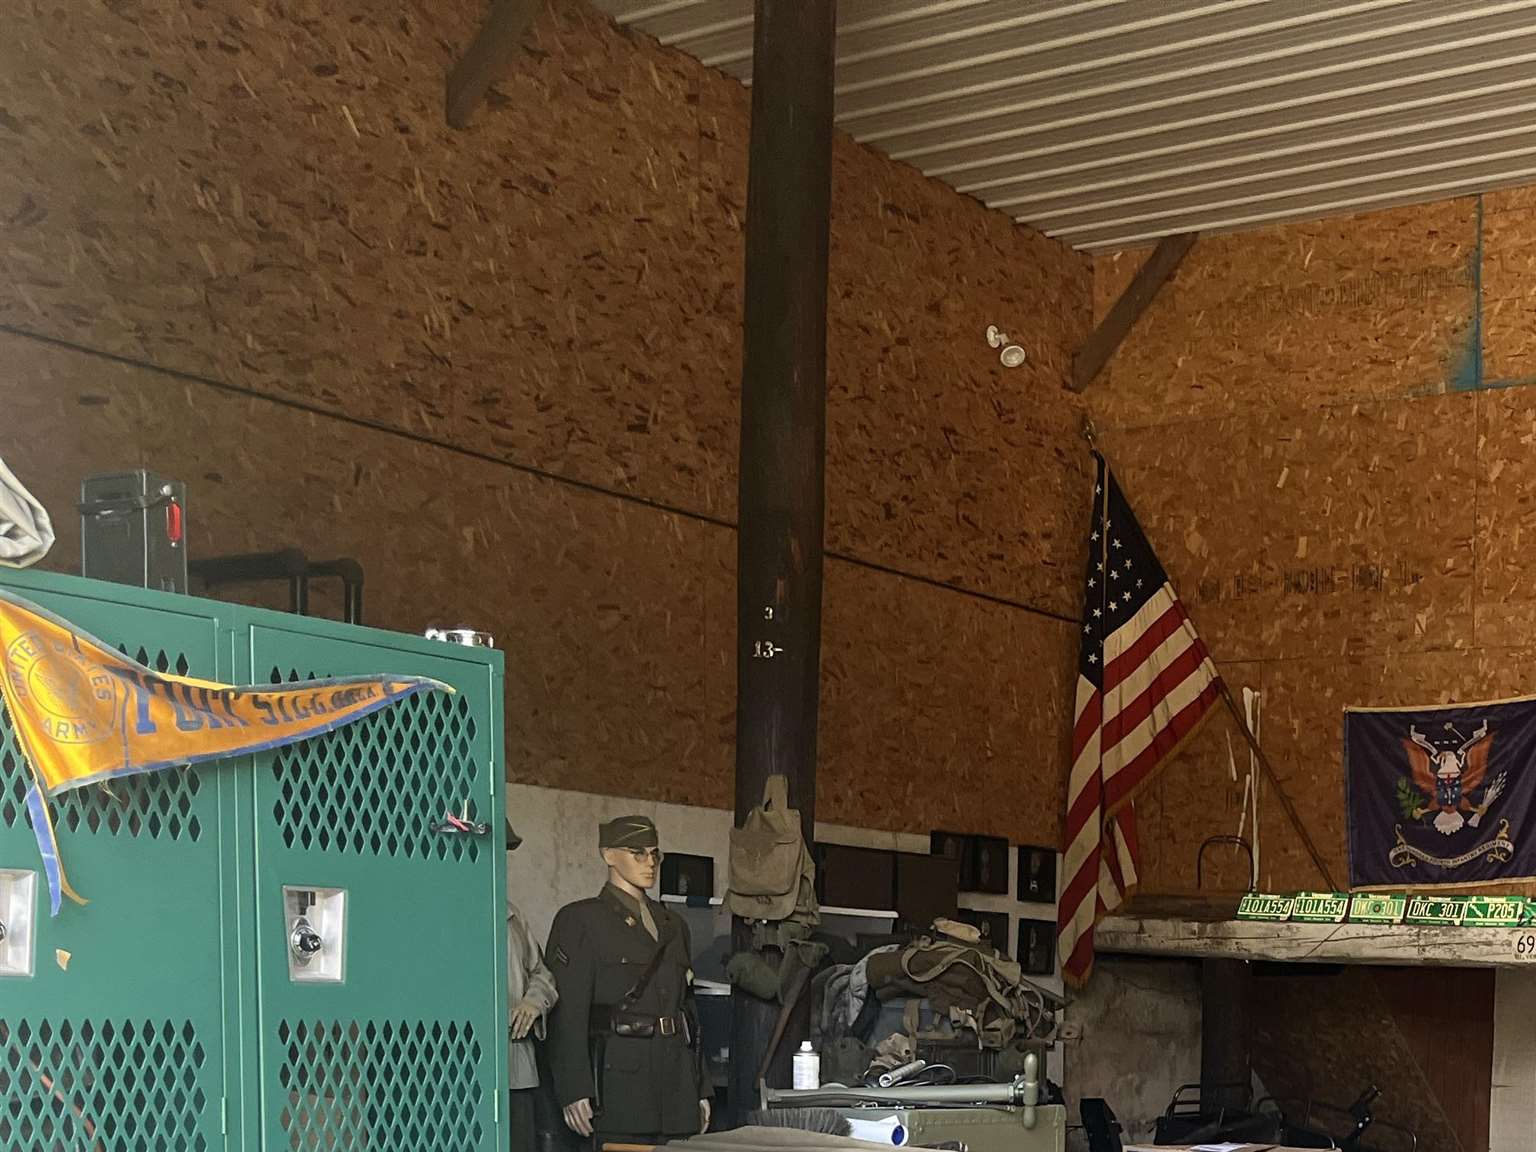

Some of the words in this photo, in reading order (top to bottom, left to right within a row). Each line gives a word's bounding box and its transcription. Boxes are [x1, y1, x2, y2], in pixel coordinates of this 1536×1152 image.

[764, 606, 774, 620] 3
[9, 633, 47, 699] UNITED
[42, 718, 98, 740] ARMY
[1299, 898, 1344, 915] 101A554
[1381, 900, 1400, 915] 301
[1412, 902, 1432, 917] DKC
[1438, 903, 1459, 918] 301
[1486, 903, 1516, 919] P205
